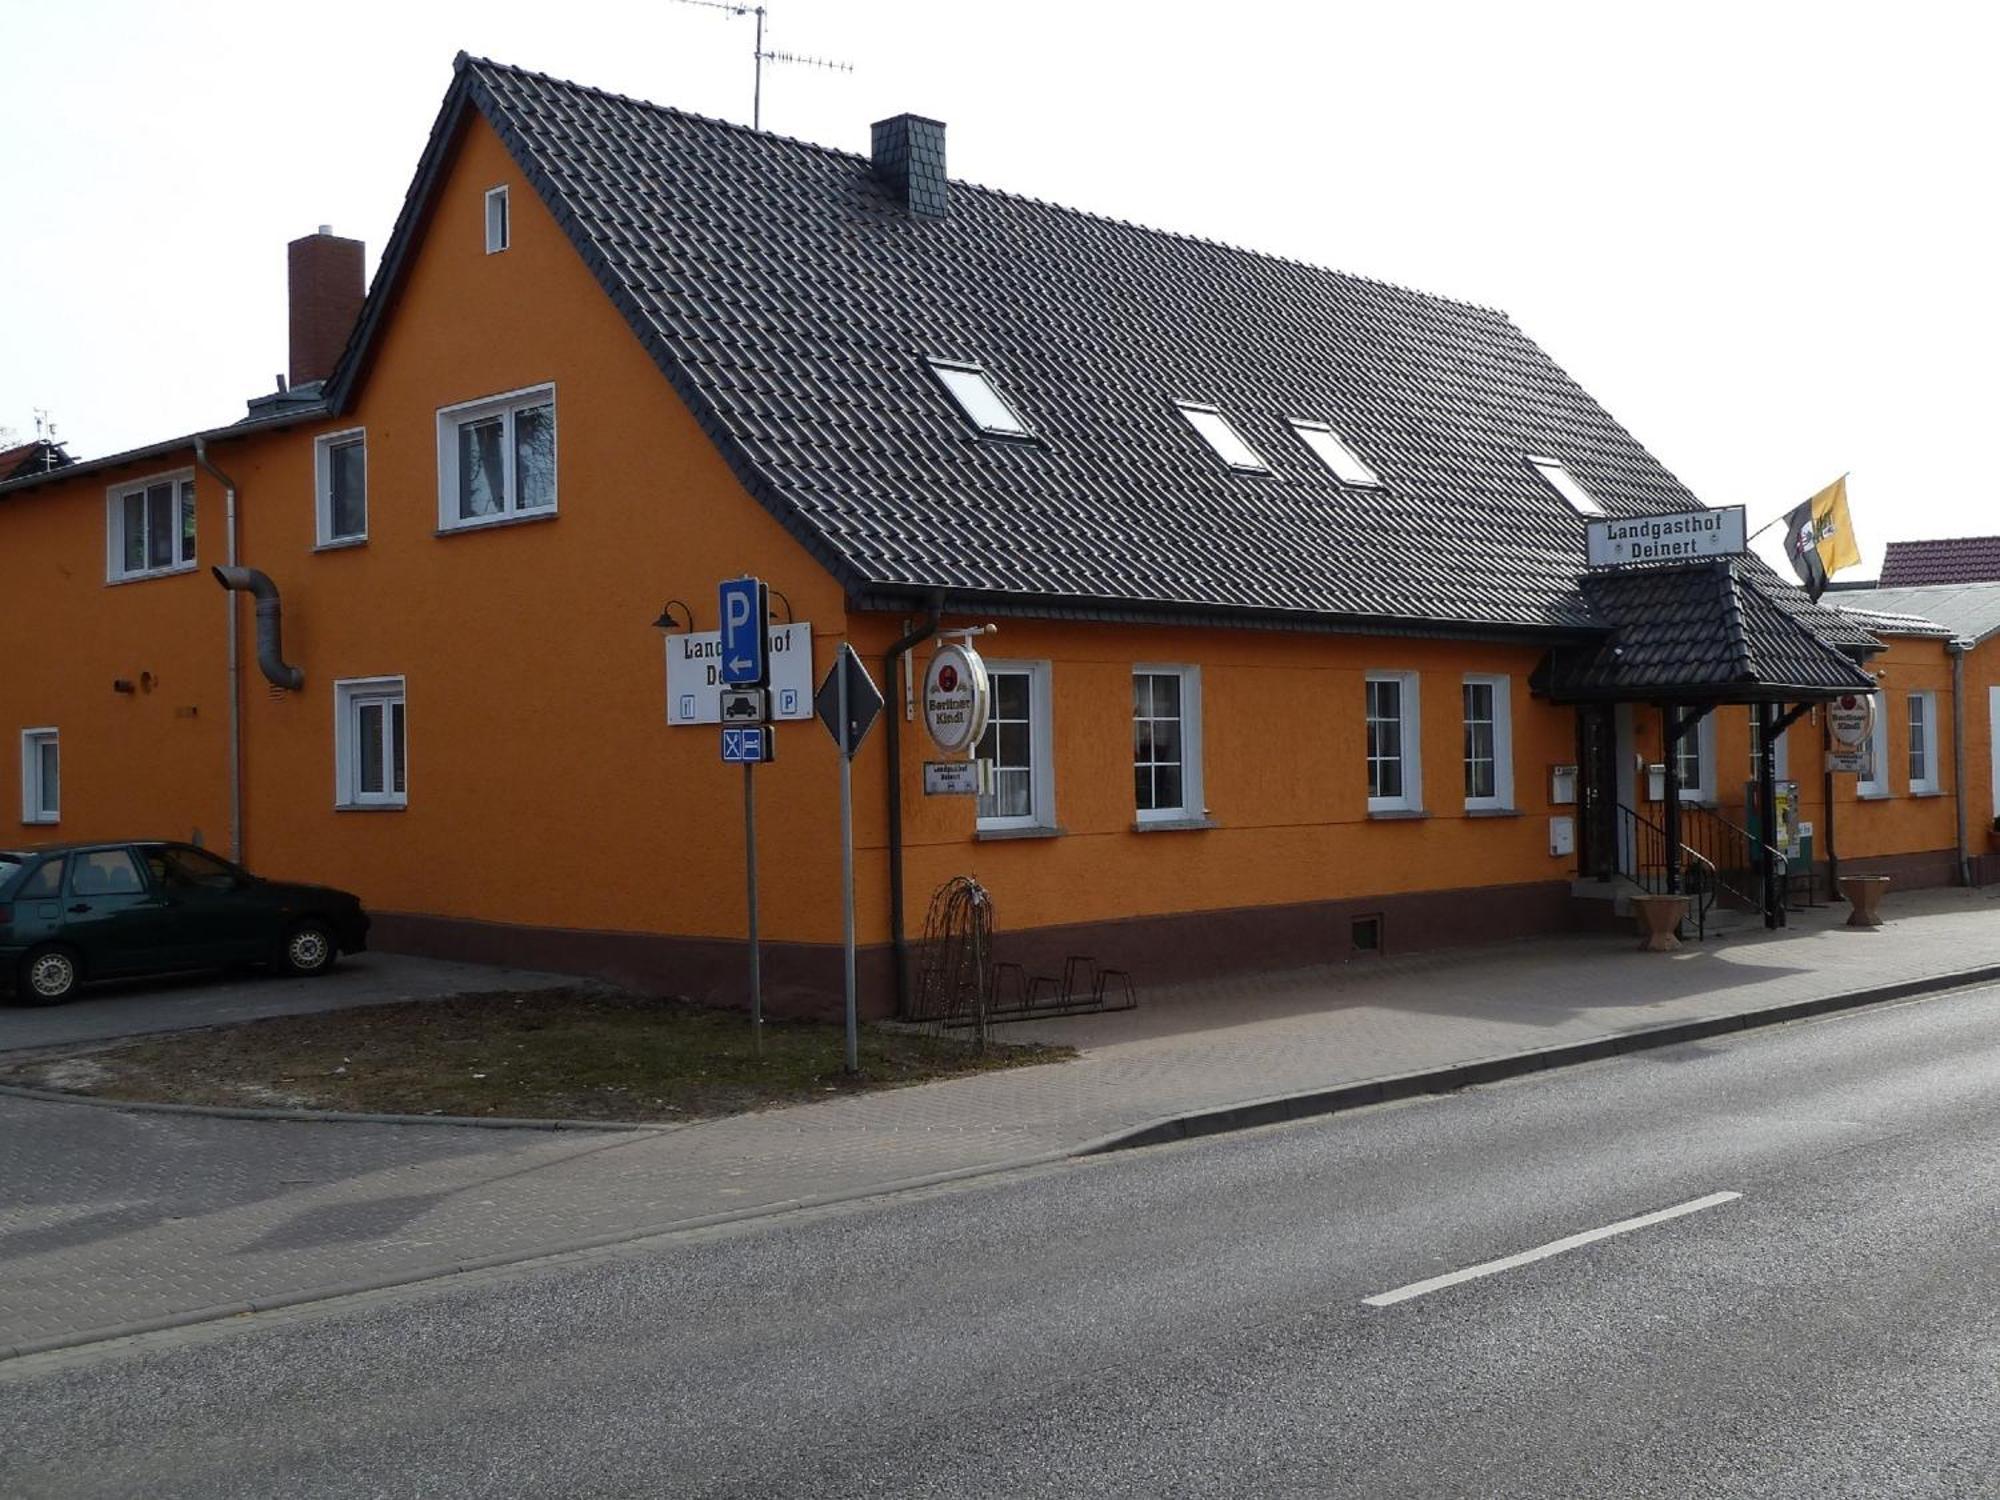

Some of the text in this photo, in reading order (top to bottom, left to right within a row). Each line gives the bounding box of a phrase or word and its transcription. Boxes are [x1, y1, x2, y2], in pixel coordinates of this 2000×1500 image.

[1607, 514, 1722, 541] Landgasthof
[1631, 538, 1697, 558] Deinert
[726, 591, 750, 649] P
[929, 698, 970, 711] Berliner
[936, 711, 964, 724] Kindl
